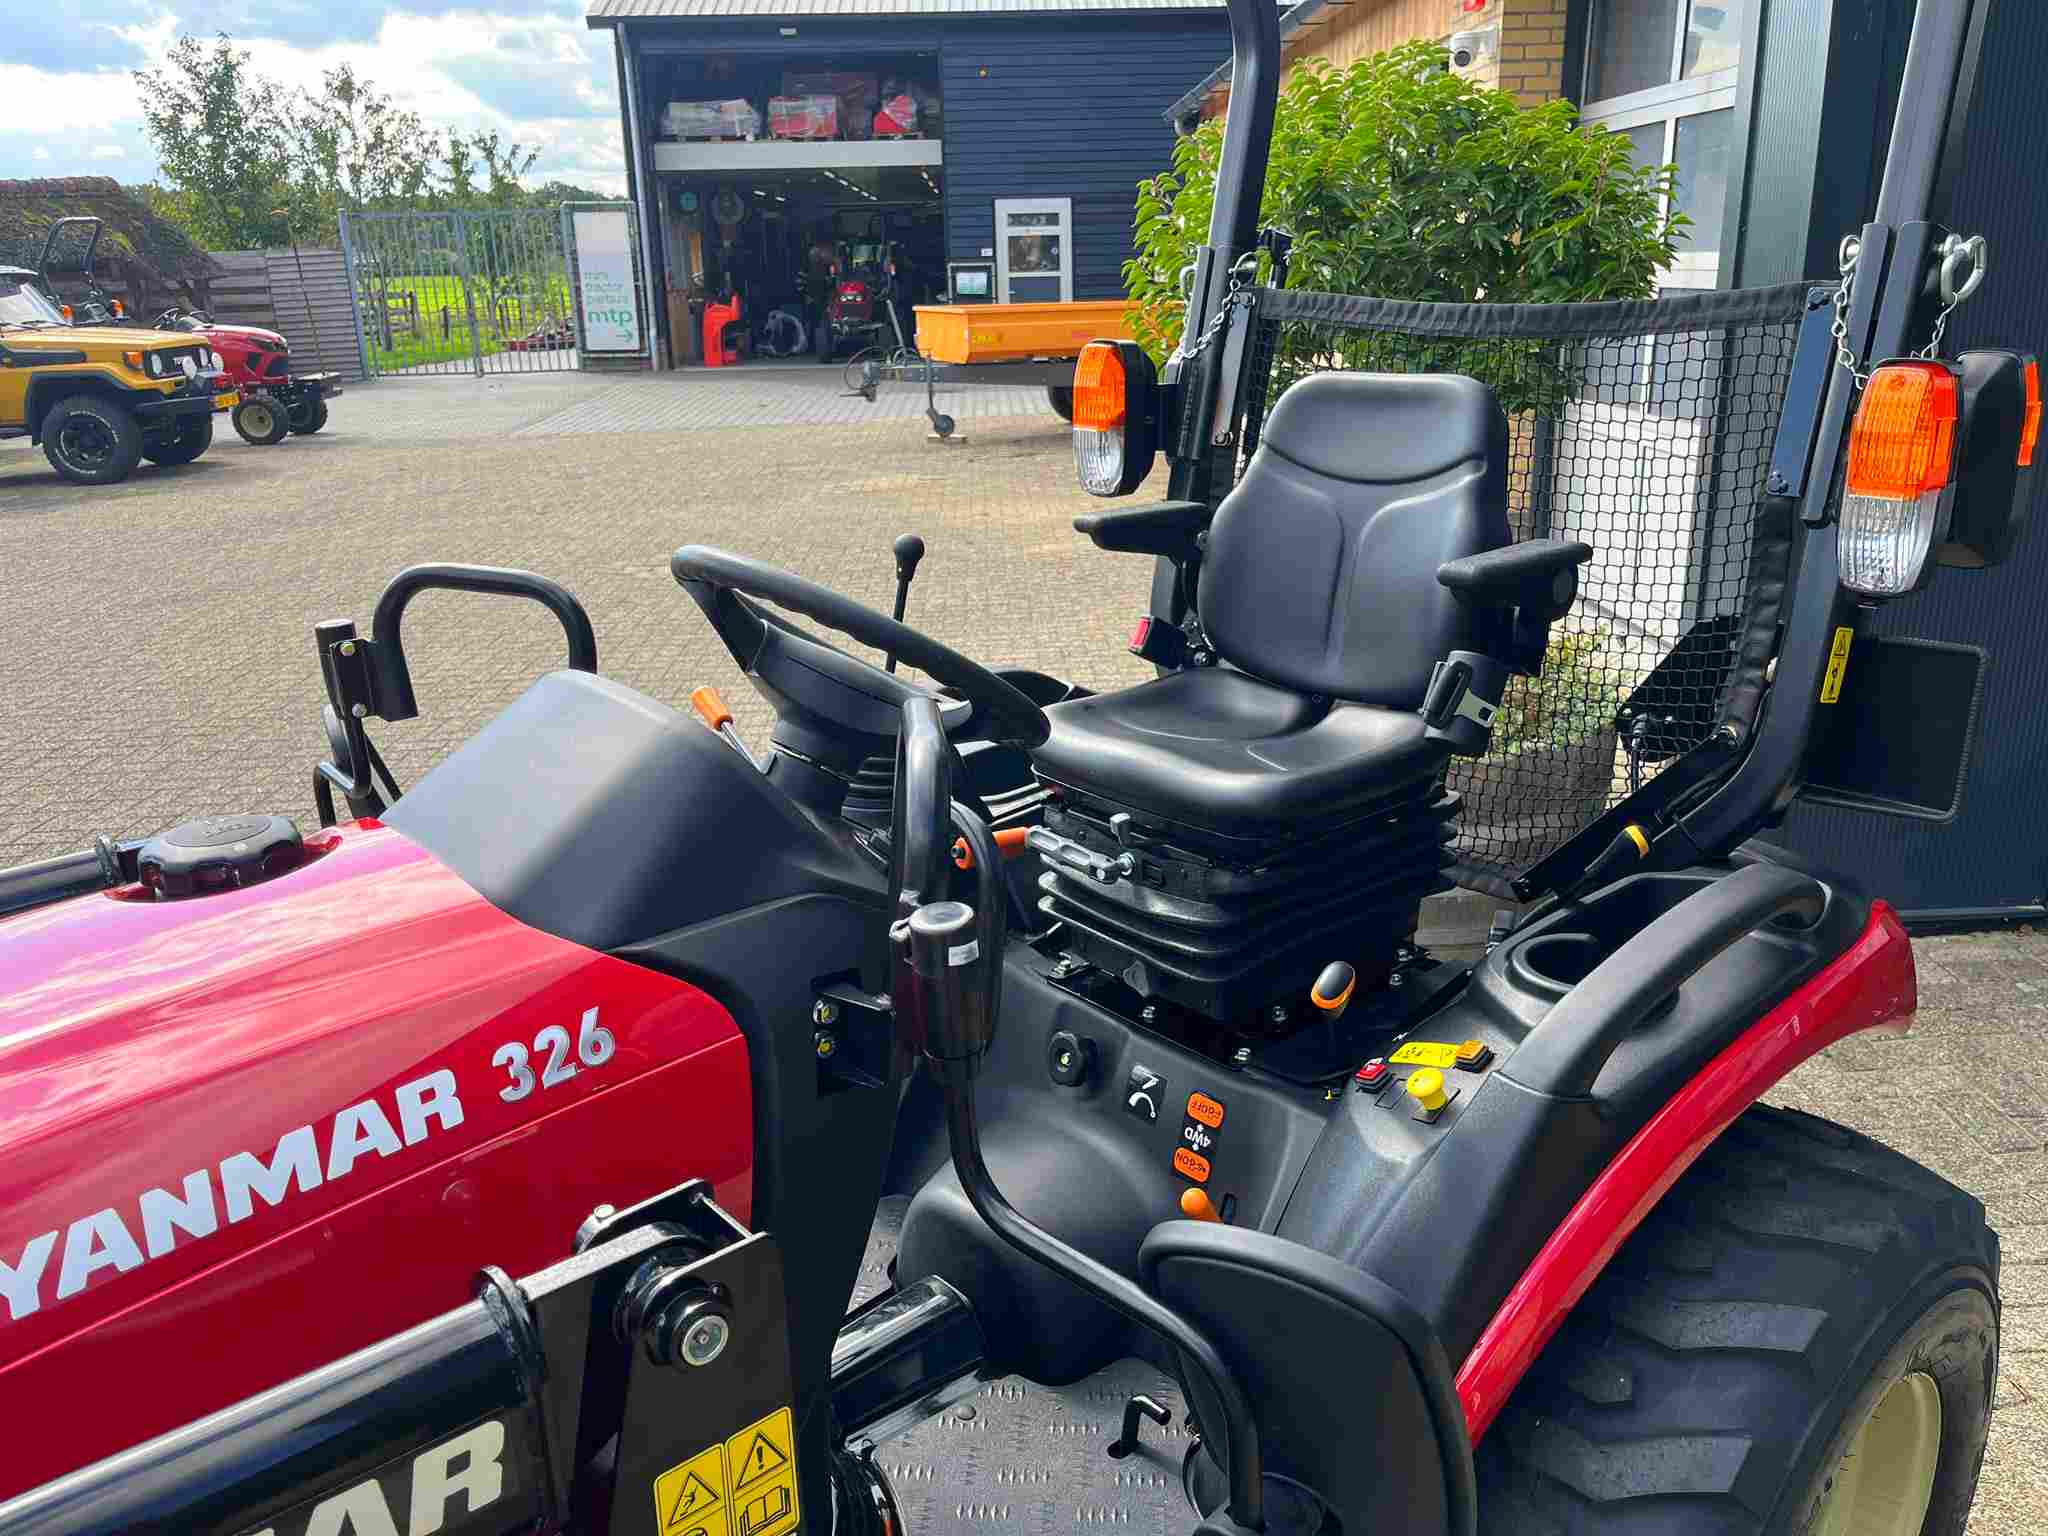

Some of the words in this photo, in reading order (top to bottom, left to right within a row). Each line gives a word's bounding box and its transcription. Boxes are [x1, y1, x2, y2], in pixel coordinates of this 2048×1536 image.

[588, 308, 632, 326] mtp
[0, 1068, 465, 1321] YANMAR
[491, 1006, 616, 1104] 326
[1184, 1127, 1211, 1148] 4WD
[234, 1420, 505, 1536] AR
